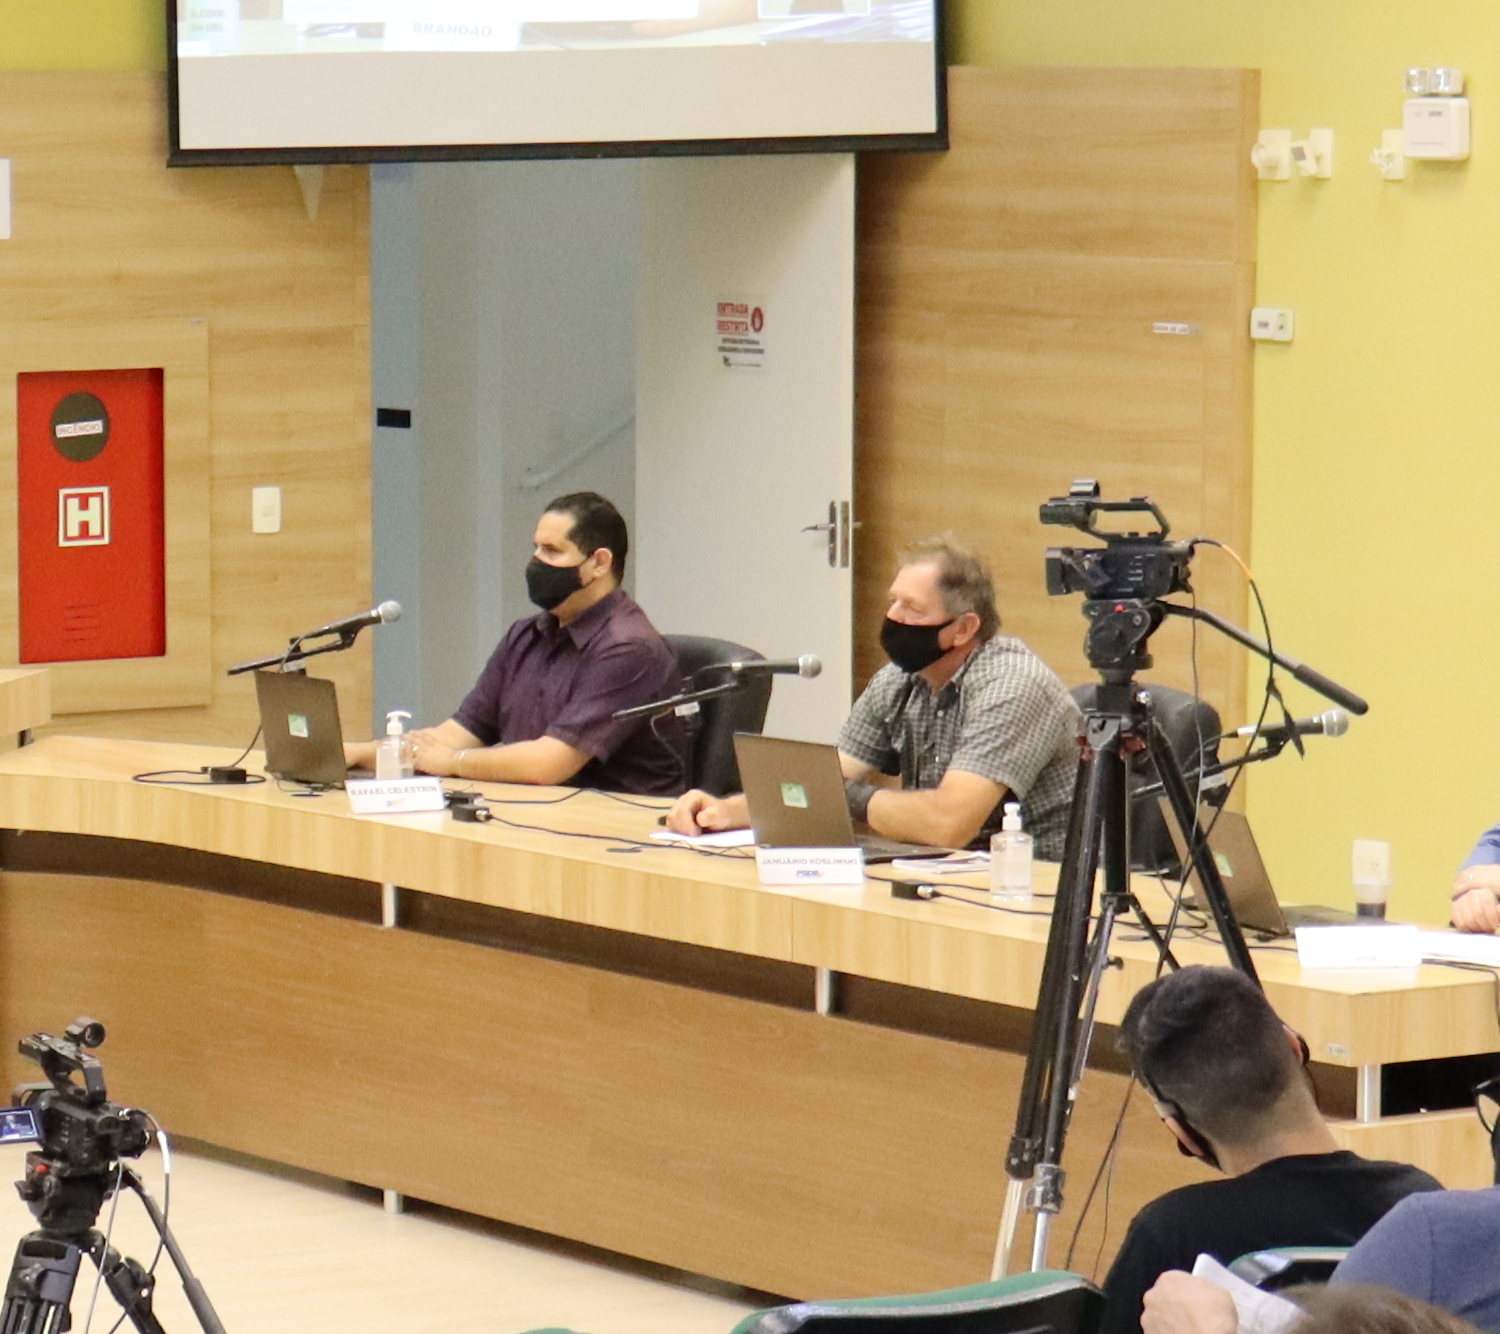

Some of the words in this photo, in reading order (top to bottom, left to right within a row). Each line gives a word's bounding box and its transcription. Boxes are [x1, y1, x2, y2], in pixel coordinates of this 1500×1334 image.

[56, 420, 102, 436] INCÊNDIO
[66, 497, 102, 538] H
[350, 788, 386, 796] RAFAEL
[387, 785, 438, 795] CELESTRIN
[761, 857, 807, 865] JANUÁRIO
